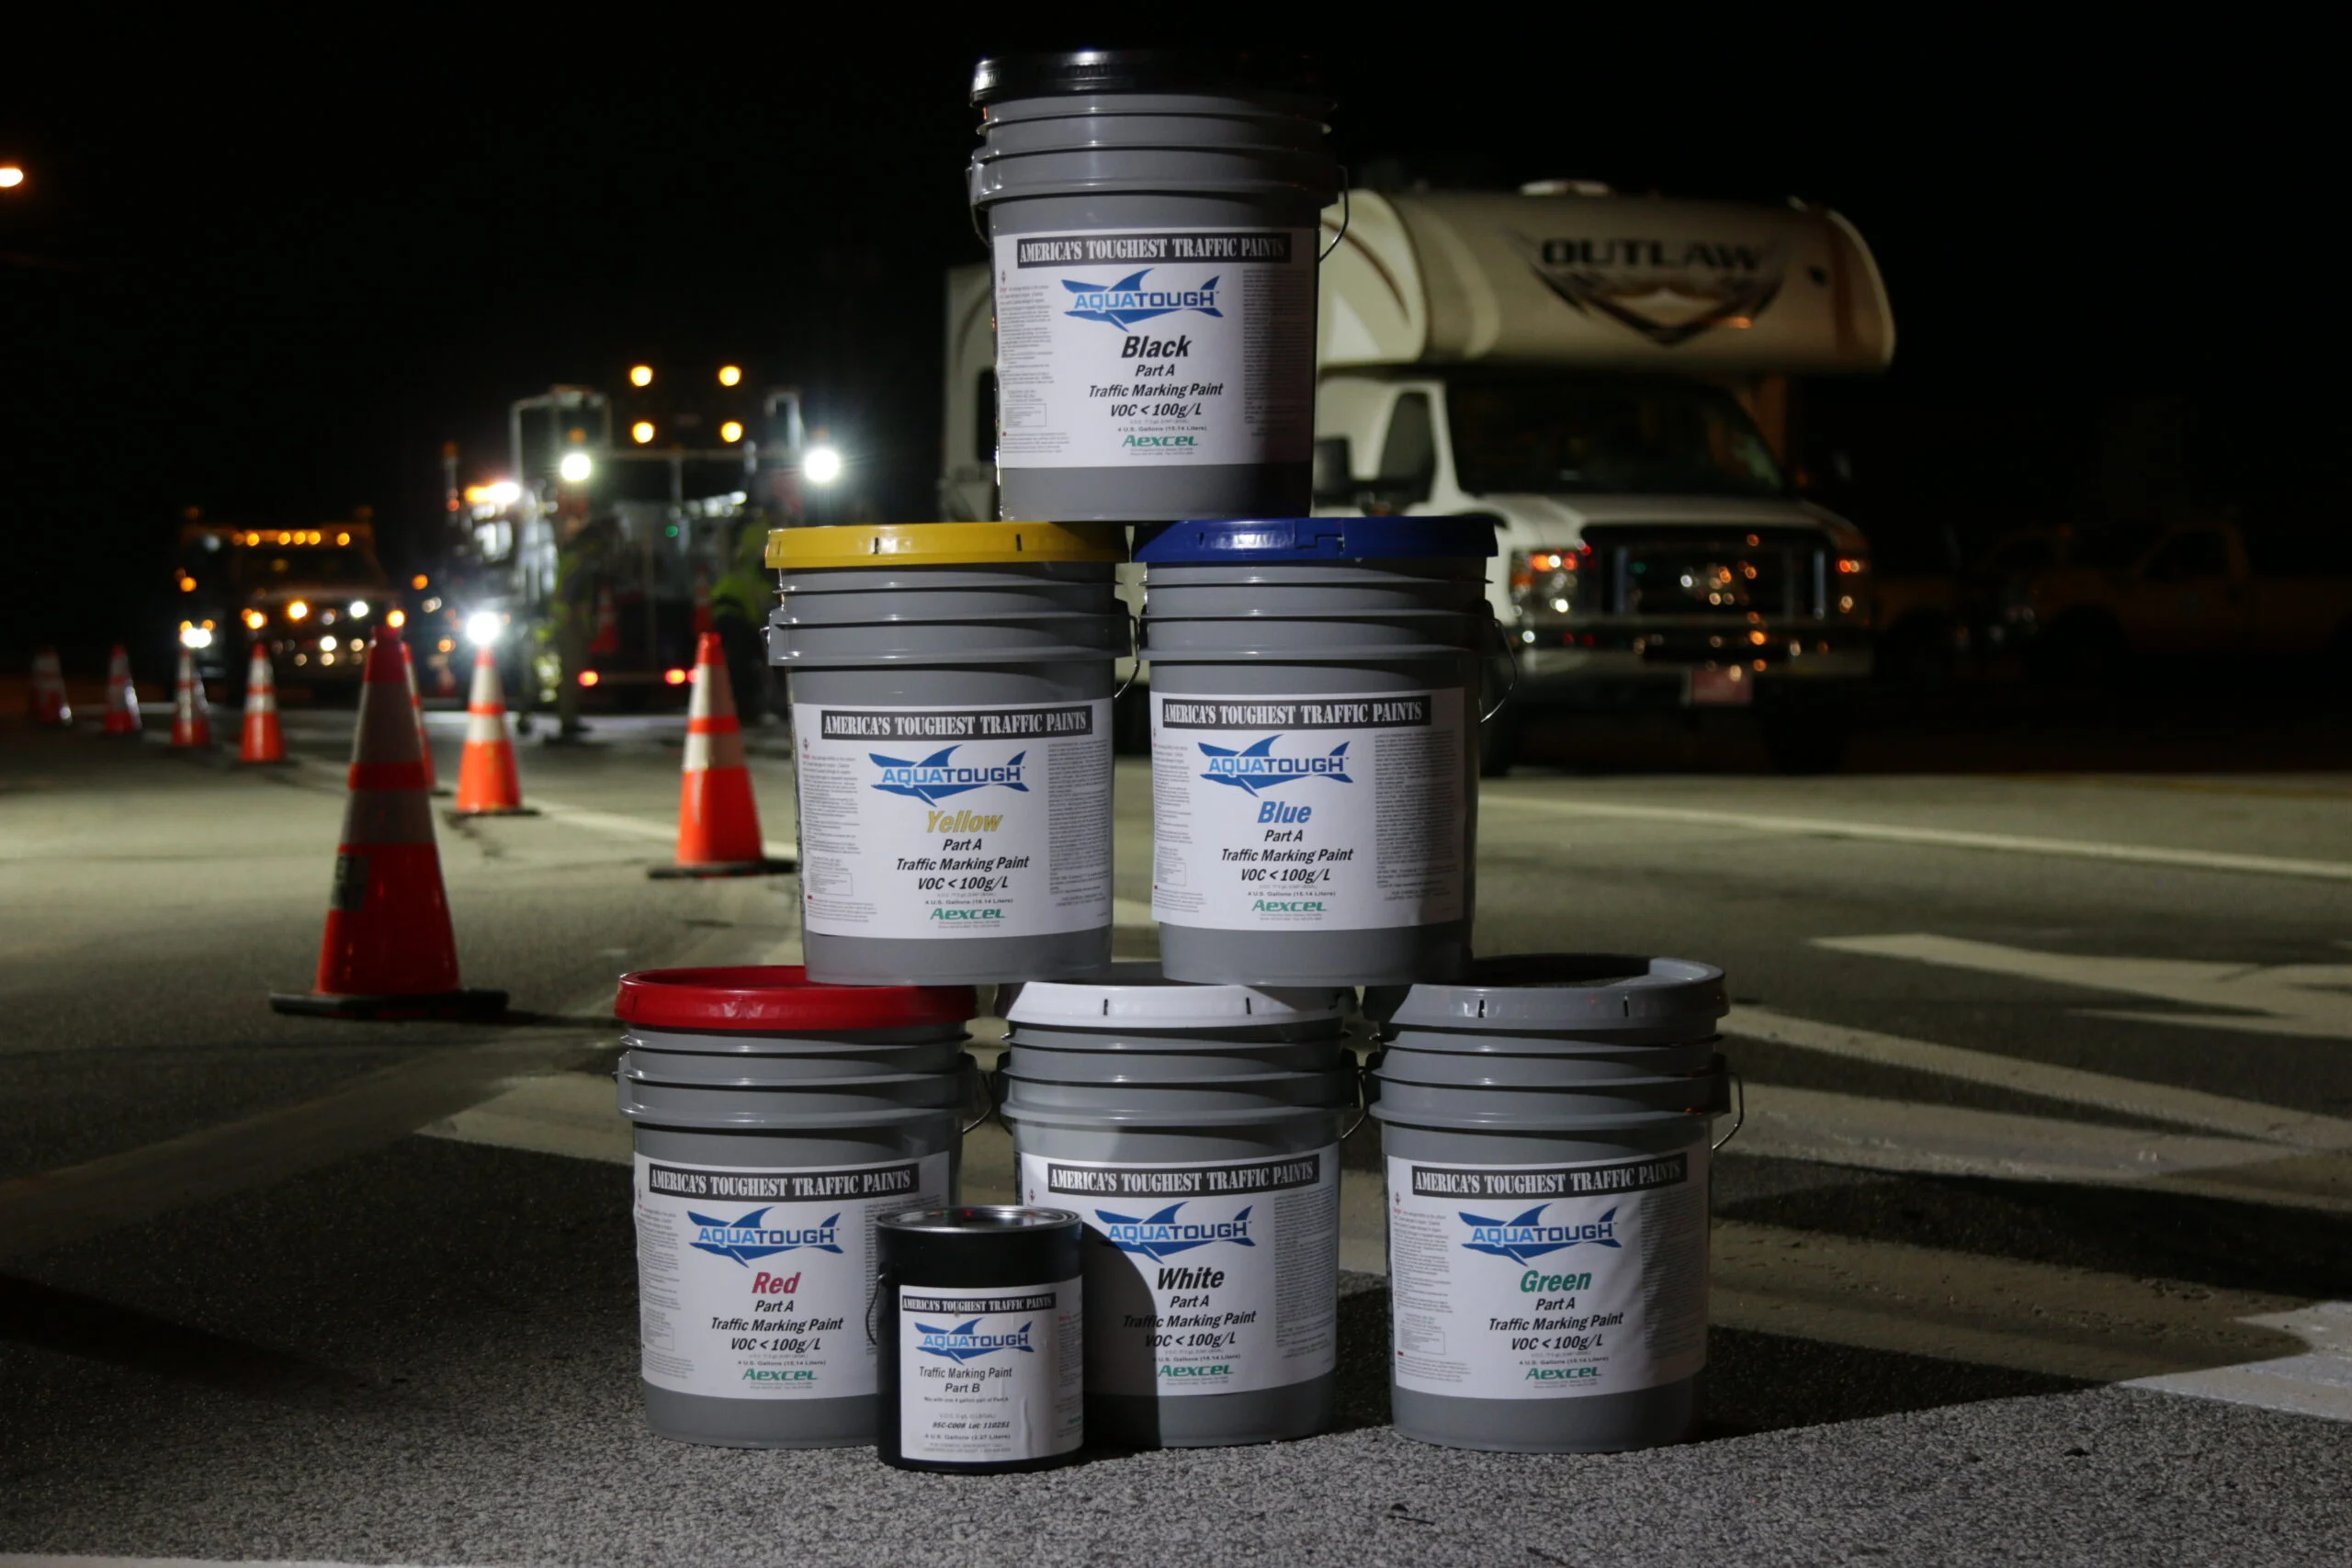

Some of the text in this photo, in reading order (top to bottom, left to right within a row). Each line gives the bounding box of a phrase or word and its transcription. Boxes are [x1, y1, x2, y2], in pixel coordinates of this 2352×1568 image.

[1020, 238, 1285, 264] AMERICA'S TOUGHEST TRAFFIC PAINTS
[1542, 237, 1760, 270] OUTLAW
[1073, 290, 1215, 310] AQUATOUGH
[1121, 335, 1193, 359] Black
[1135, 364, 1176, 378] Part A
[1089, 382, 1224, 400] Traffic Marking Paint
[1110, 402, 1203, 419] VOC < 100g/L
[1163, 701, 1423, 725] AMERICA'S TOUGHEST TRAFFIC PAINTS
[824, 710, 1087, 736] AMERICA'S TOUGHEST TRAFFIC PAINTS
[1208, 757, 1344, 773] AQUATOUGH
[881, 766, 1022, 783] AQUATOUGH
[1257, 800, 1312, 824] Blue
[926, 810, 1003, 834] Yellow
[1263, 829, 1304, 842] Part A
[942, 839, 983, 852] Part A
[896, 855, 1029, 873] Traffic Marking Paint
[1221, 848, 1354, 863] Traffic Marking Paint
[918, 875, 1009, 893] VOC < 100g/L
[1240, 868, 1331, 884] VOC < 100g/L
[650, 1169, 910, 1198] AMERICA'S TOUGHEST TRAFFIC PAINTS
[1050, 1162, 1314, 1192] AMERICA'S TOUGHEST TRAFFIC PAINTS
[1415, 1161, 1681, 1194] AMERICA'S TOUGHEST TRAFFIC PAINTS
[698, 1227, 835, 1246] AQUATOUGH
[1108, 1222, 1248, 1241] AQUATOUGH
[1472, 1223, 1613, 1243] AQUATOUGH
[751, 1271, 801, 1294] Red
[1157, 1267, 1225, 1291] White
[1520, 1269, 1592, 1293] Green
[754, 1300, 795, 1313] Part A
[903, 1296, 1051, 1312] AMERICA'S TOUGHEST TRAFFIC PAINTS
[1170, 1295, 1209, 1309] Part A
[1535, 1297, 1576, 1311] Part A
[710, 1317, 844, 1334] Traffic Marking Paint
[1123, 1311, 1257, 1328] Traffic Marking Paint
[1488, 1312, 1624, 1331] Traffic Marking Paint
[730, 1337, 821, 1353] VOC < 100g/L
[923, 1334, 1029, 1348] AQUATOUGH
[1145, 1331, 1236, 1348] VOC < 100g/L
[1511, 1333, 1603, 1350] VOC < 100g/L
[919, 1366, 1012, 1381] Traffic Marking Paint
[944, 1383, 980, 1393] Part B
